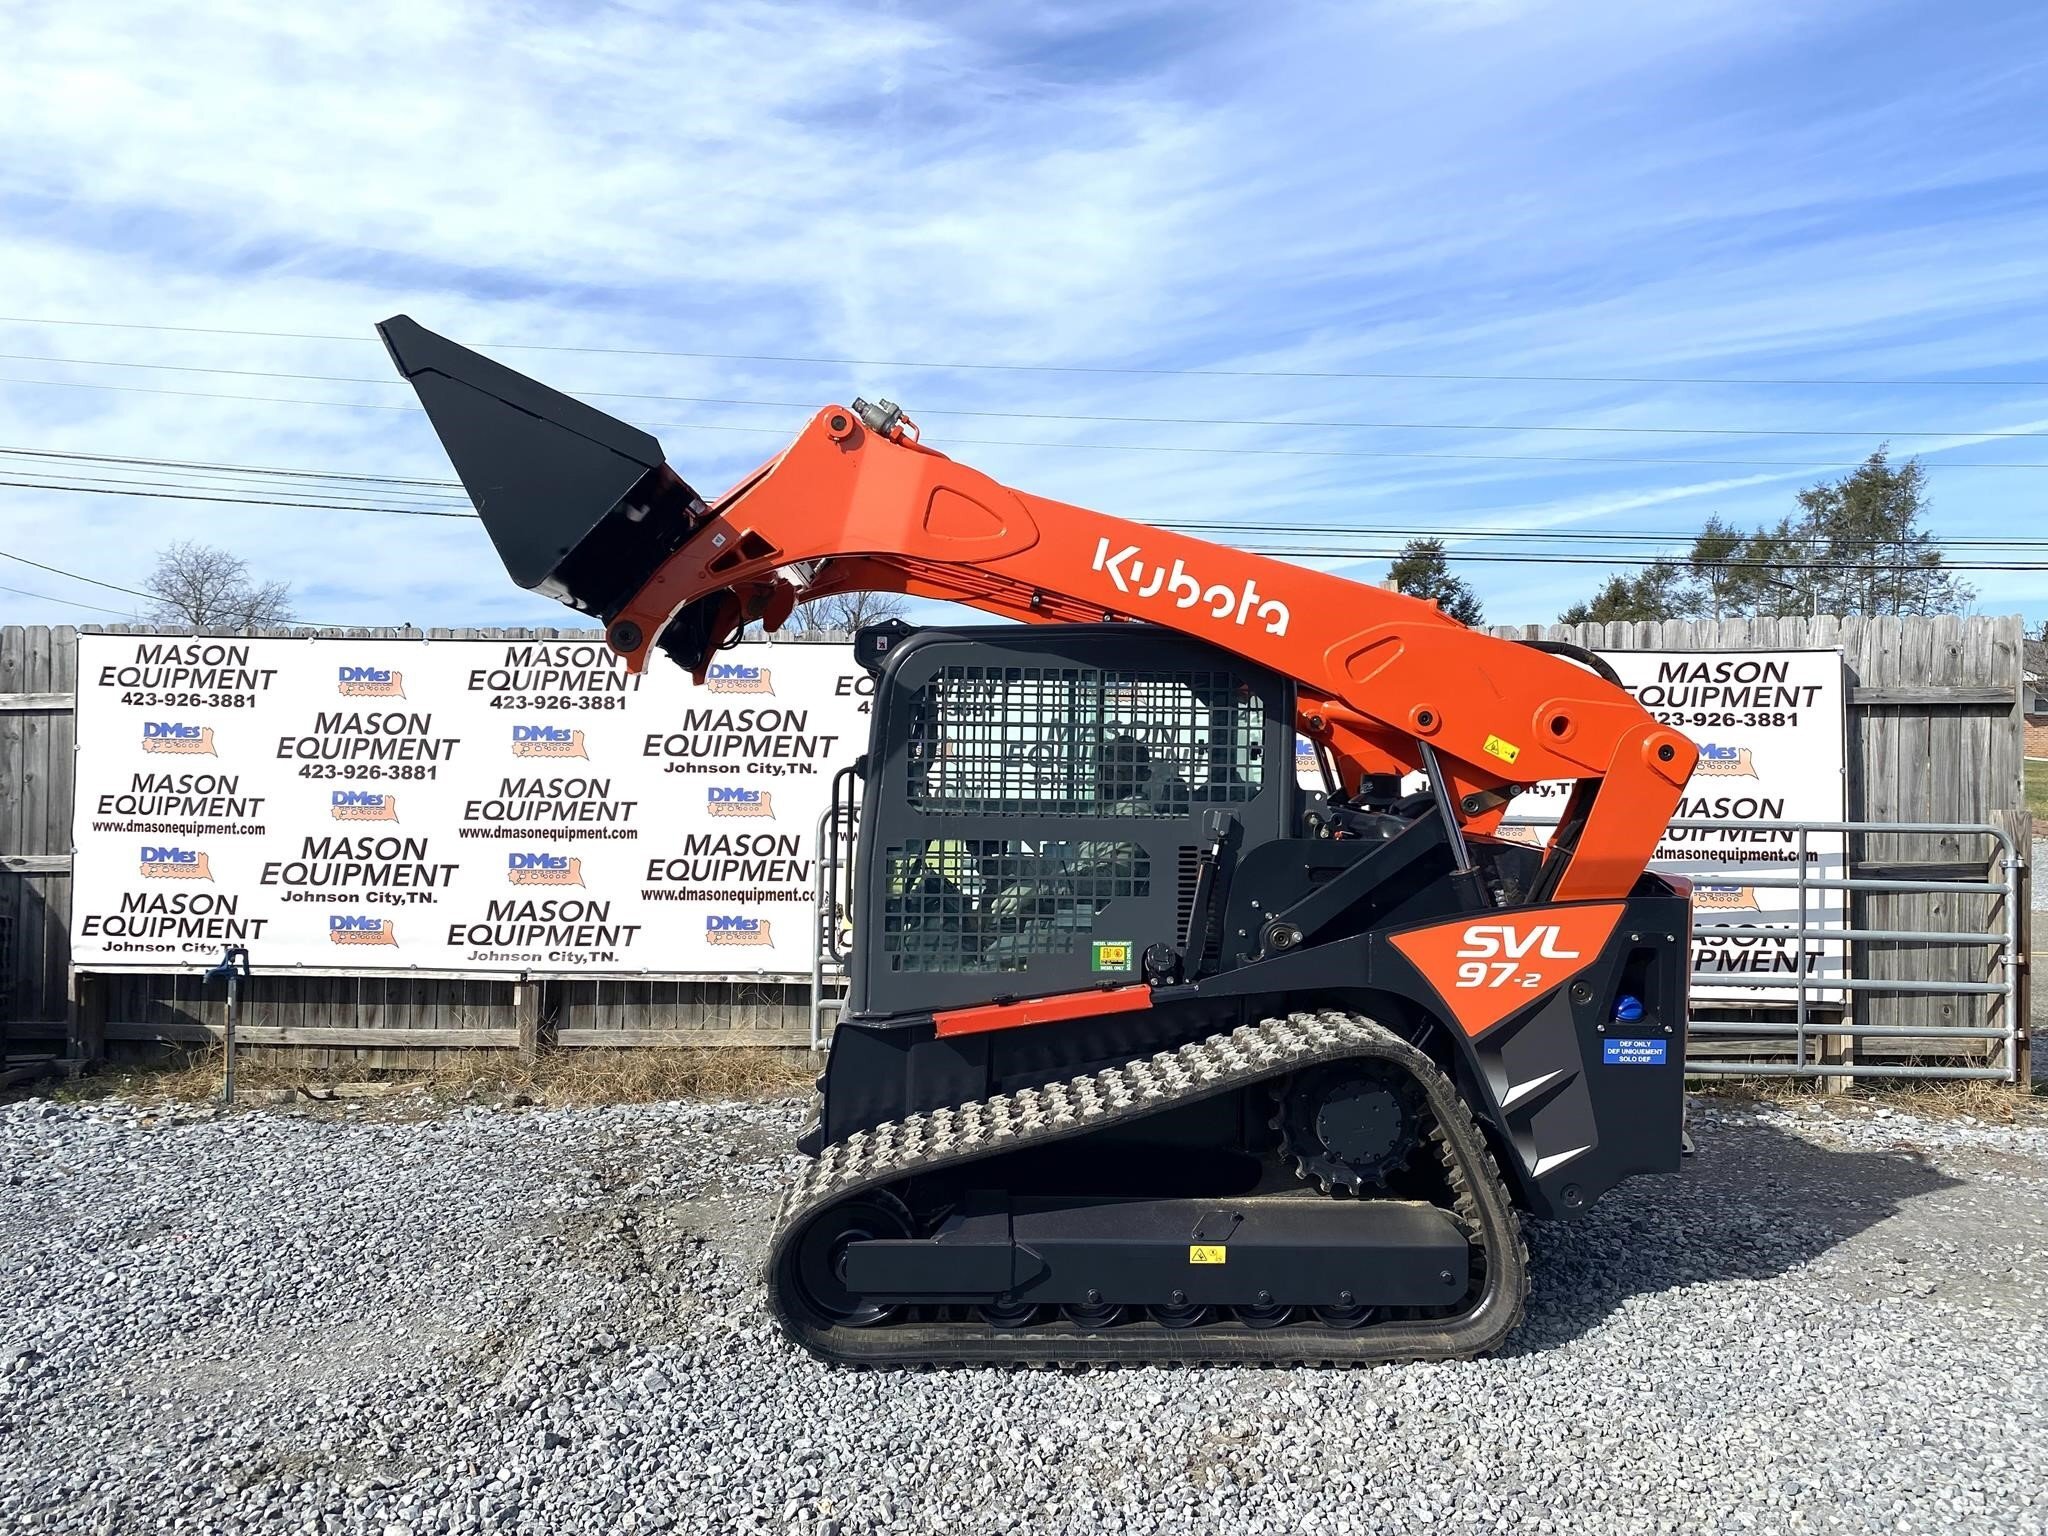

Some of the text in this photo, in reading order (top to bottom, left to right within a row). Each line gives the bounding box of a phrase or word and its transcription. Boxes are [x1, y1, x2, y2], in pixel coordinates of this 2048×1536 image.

[1091, 536, 1291, 637] Kubota
[136, 645, 249, 666] MASON
[505, 645, 618, 667] MASON
[99, 665, 277, 689] EQUIPMENT
[1658, 662, 1789, 683] MASON
[121, 692, 254, 707] 423-926-3881
[490, 696, 625, 709] 423-926-3881
[315, 713, 431, 735] MASON
[683, 709, 807, 732] MASON
[1649, 711, 1800, 728] 23-926-3881
[277, 734, 460, 760] EQUIPMENT
[643, 734, 838, 757] EQUIPMENT
[299, 764, 436, 779] 423-926-3881
[664, 762, 739, 773] Johnson
[131, 774, 239, 795] MASON
[500, 779, 610, 798] MASON
[98, 793, 265, 817] EQUIPMENT
[464, 801, 637, 821] EQUIPMENT
[93, 816, 265, 837] www.dmasonequipment.com
[459, 826, 637, 842] www.dmasonequipment.com
[302, 837, 428, 860] MASON
[684, 834, 800, 856] MASON
[260, 863, 459, 886] EQUIPMENT
[643, 859, 815, 882] EQUIPMEN
[120, 893, 238, 915] MASON
[281, 891, 359, 902] Johnson
[641, 886, 815, 905] www.dmasonequipment.c
[487, 900, 610, 922] MASON
[82, 914, 268, 939] EQUIPMENT
[448, 925, 641, 946] EQUIPMENT
[103, 942, 175, 951] Johnson
[1456, 925, 1580, 959] SVL
[468, 951, 541, 961] Johnson
[1455, 962, 1542, 988] 97-2
